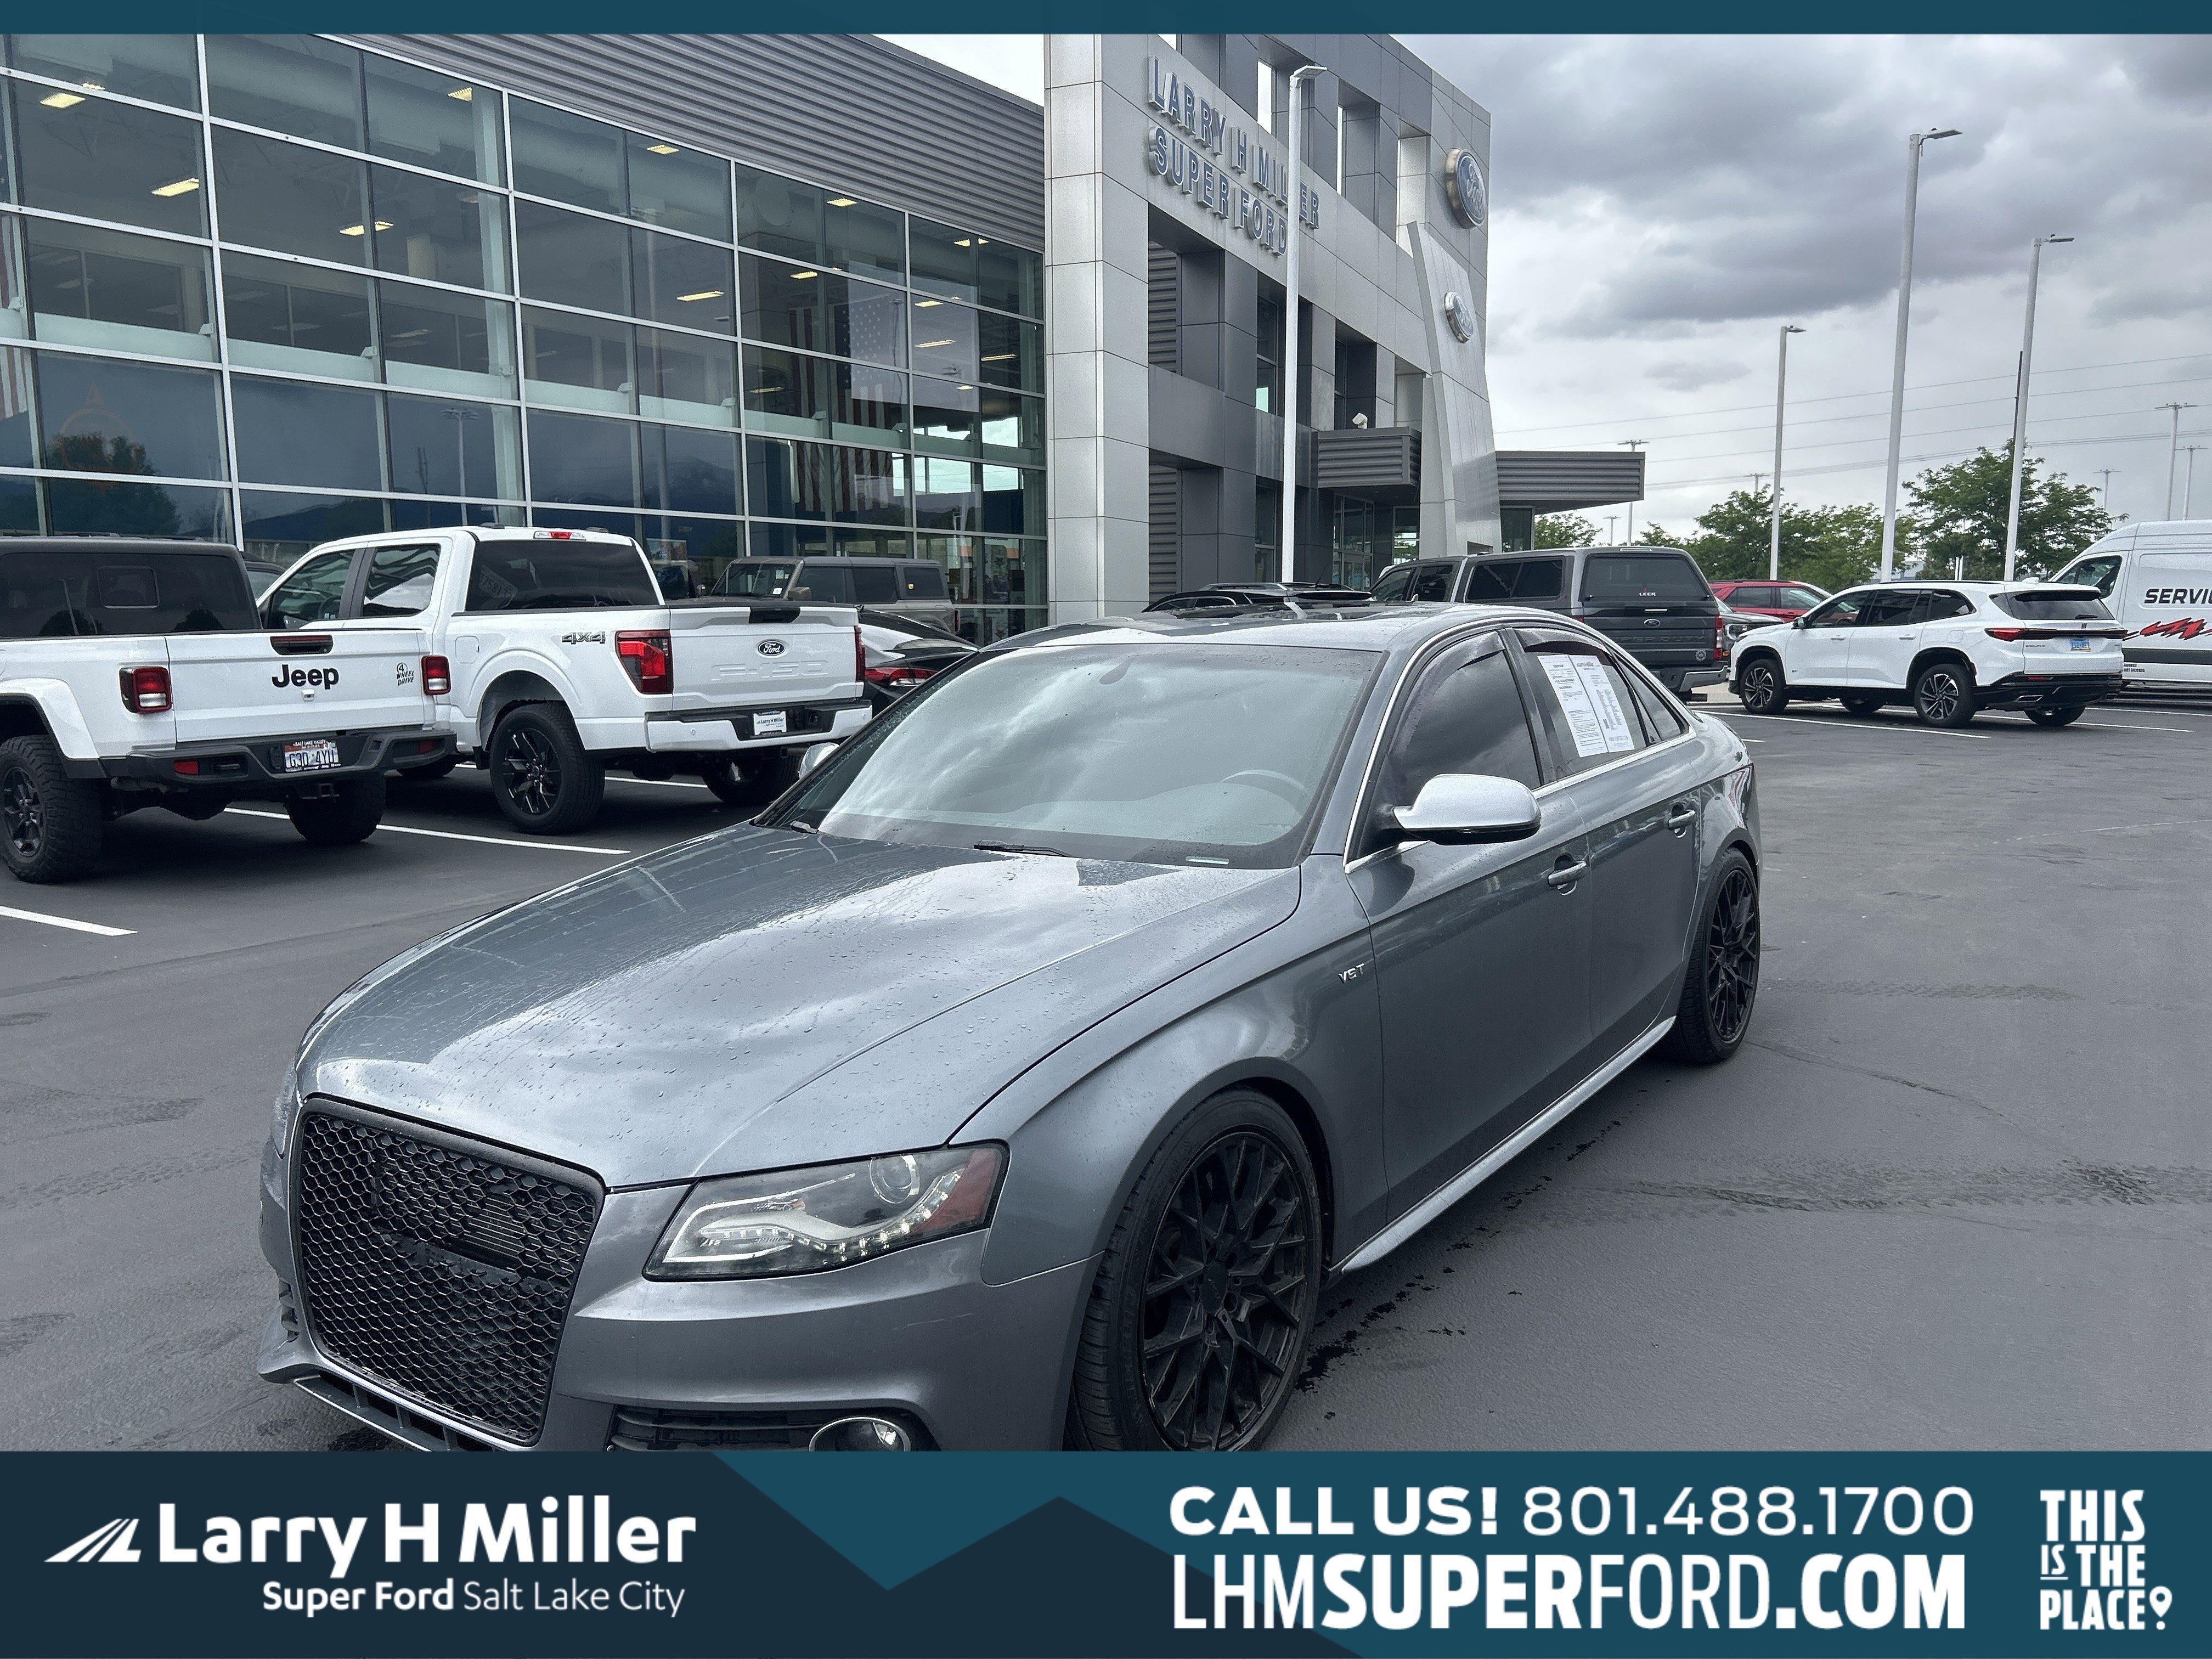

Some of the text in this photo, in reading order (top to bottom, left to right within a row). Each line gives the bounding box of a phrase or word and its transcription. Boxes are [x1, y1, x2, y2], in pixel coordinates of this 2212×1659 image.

[1149, 55, 1319, 230] LARRY H MILER
[1149, 127, 1288, 256] SUPER FORD
[763, 643, 781, 653] Ford
[272, 664, 339, 690] Jeep
[396, 670, 414, 680] WHEEL
[397, 676, 415, 686] DRIVE
[712, 660, 828, 681] F-150
